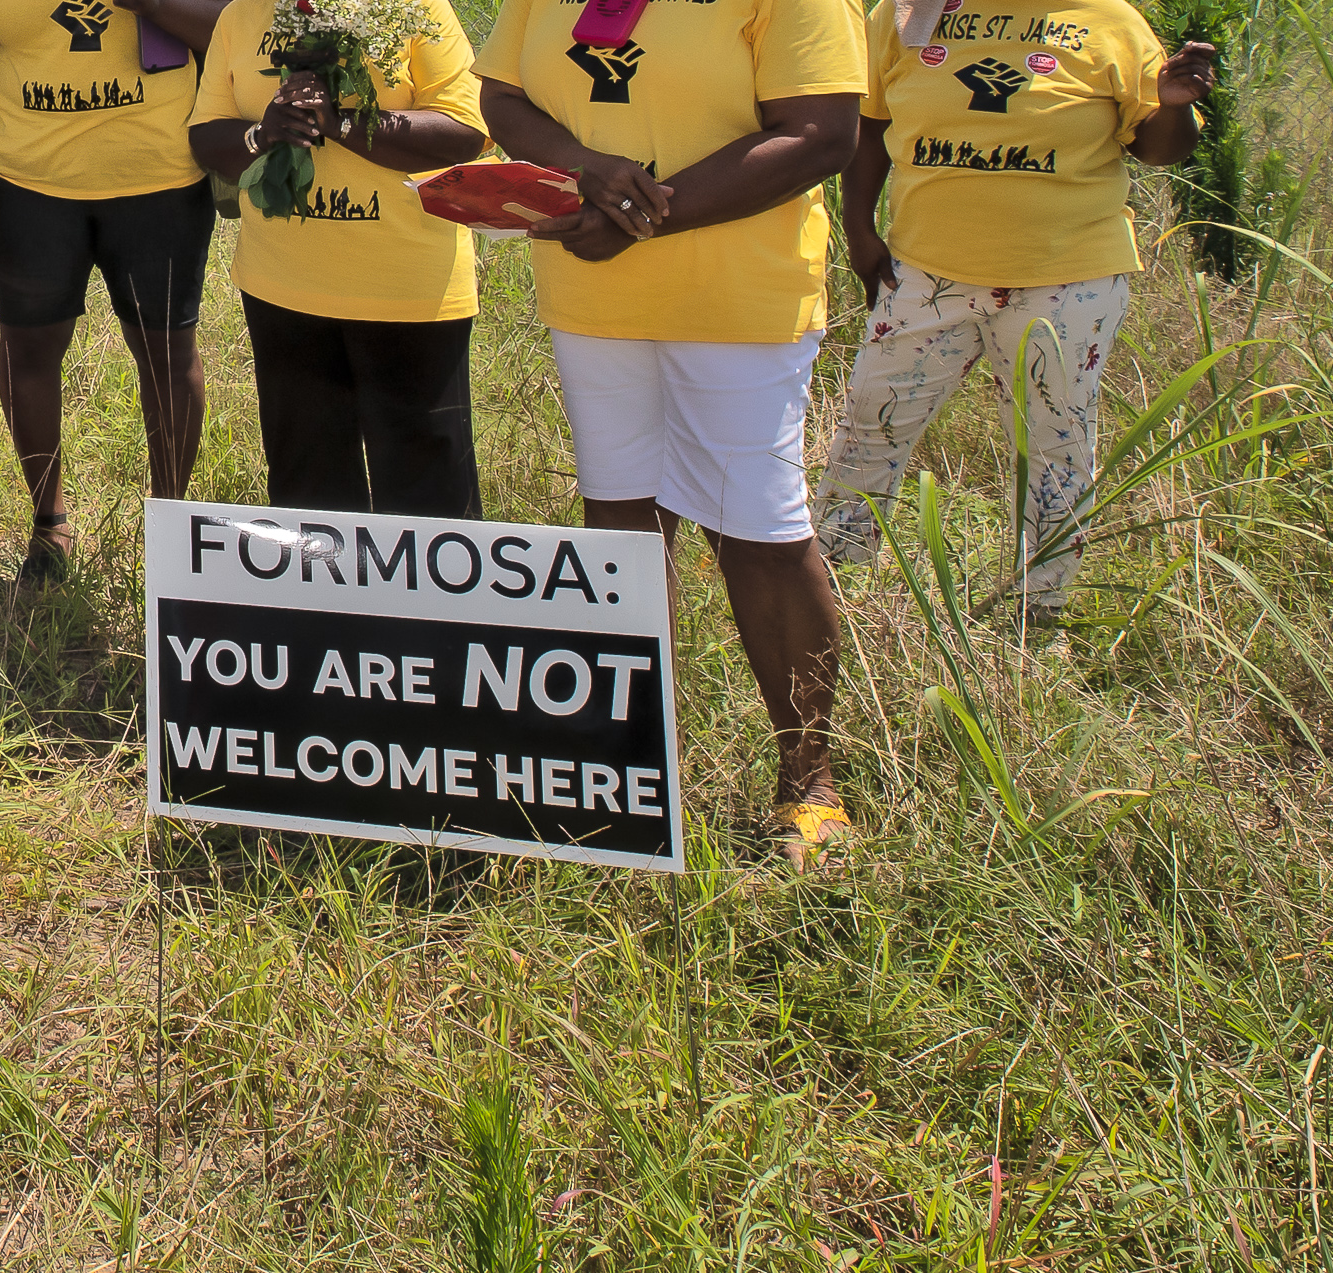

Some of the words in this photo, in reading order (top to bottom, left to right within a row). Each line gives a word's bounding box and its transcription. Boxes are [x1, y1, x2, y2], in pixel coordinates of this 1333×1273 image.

[925, 47, 945, 55] STOP
[936, 13, 981, 40] RISE
[983, 14, 1013, 40] ST.
[1020, 18, 1090, 52] JAMES
[1031, 56, 1054, 64] STOP
[427, 170, 464, 190] STOP
[191, 514, 621, 606] FORMOSA:
[167, 635, 289, 690] YOU
[313, 650, 436, 704] ARE
[461, 643, 651, 721] NOT
[166, 722, 479, 798] WELCOME
[496, 754, 663, 818] HERE
